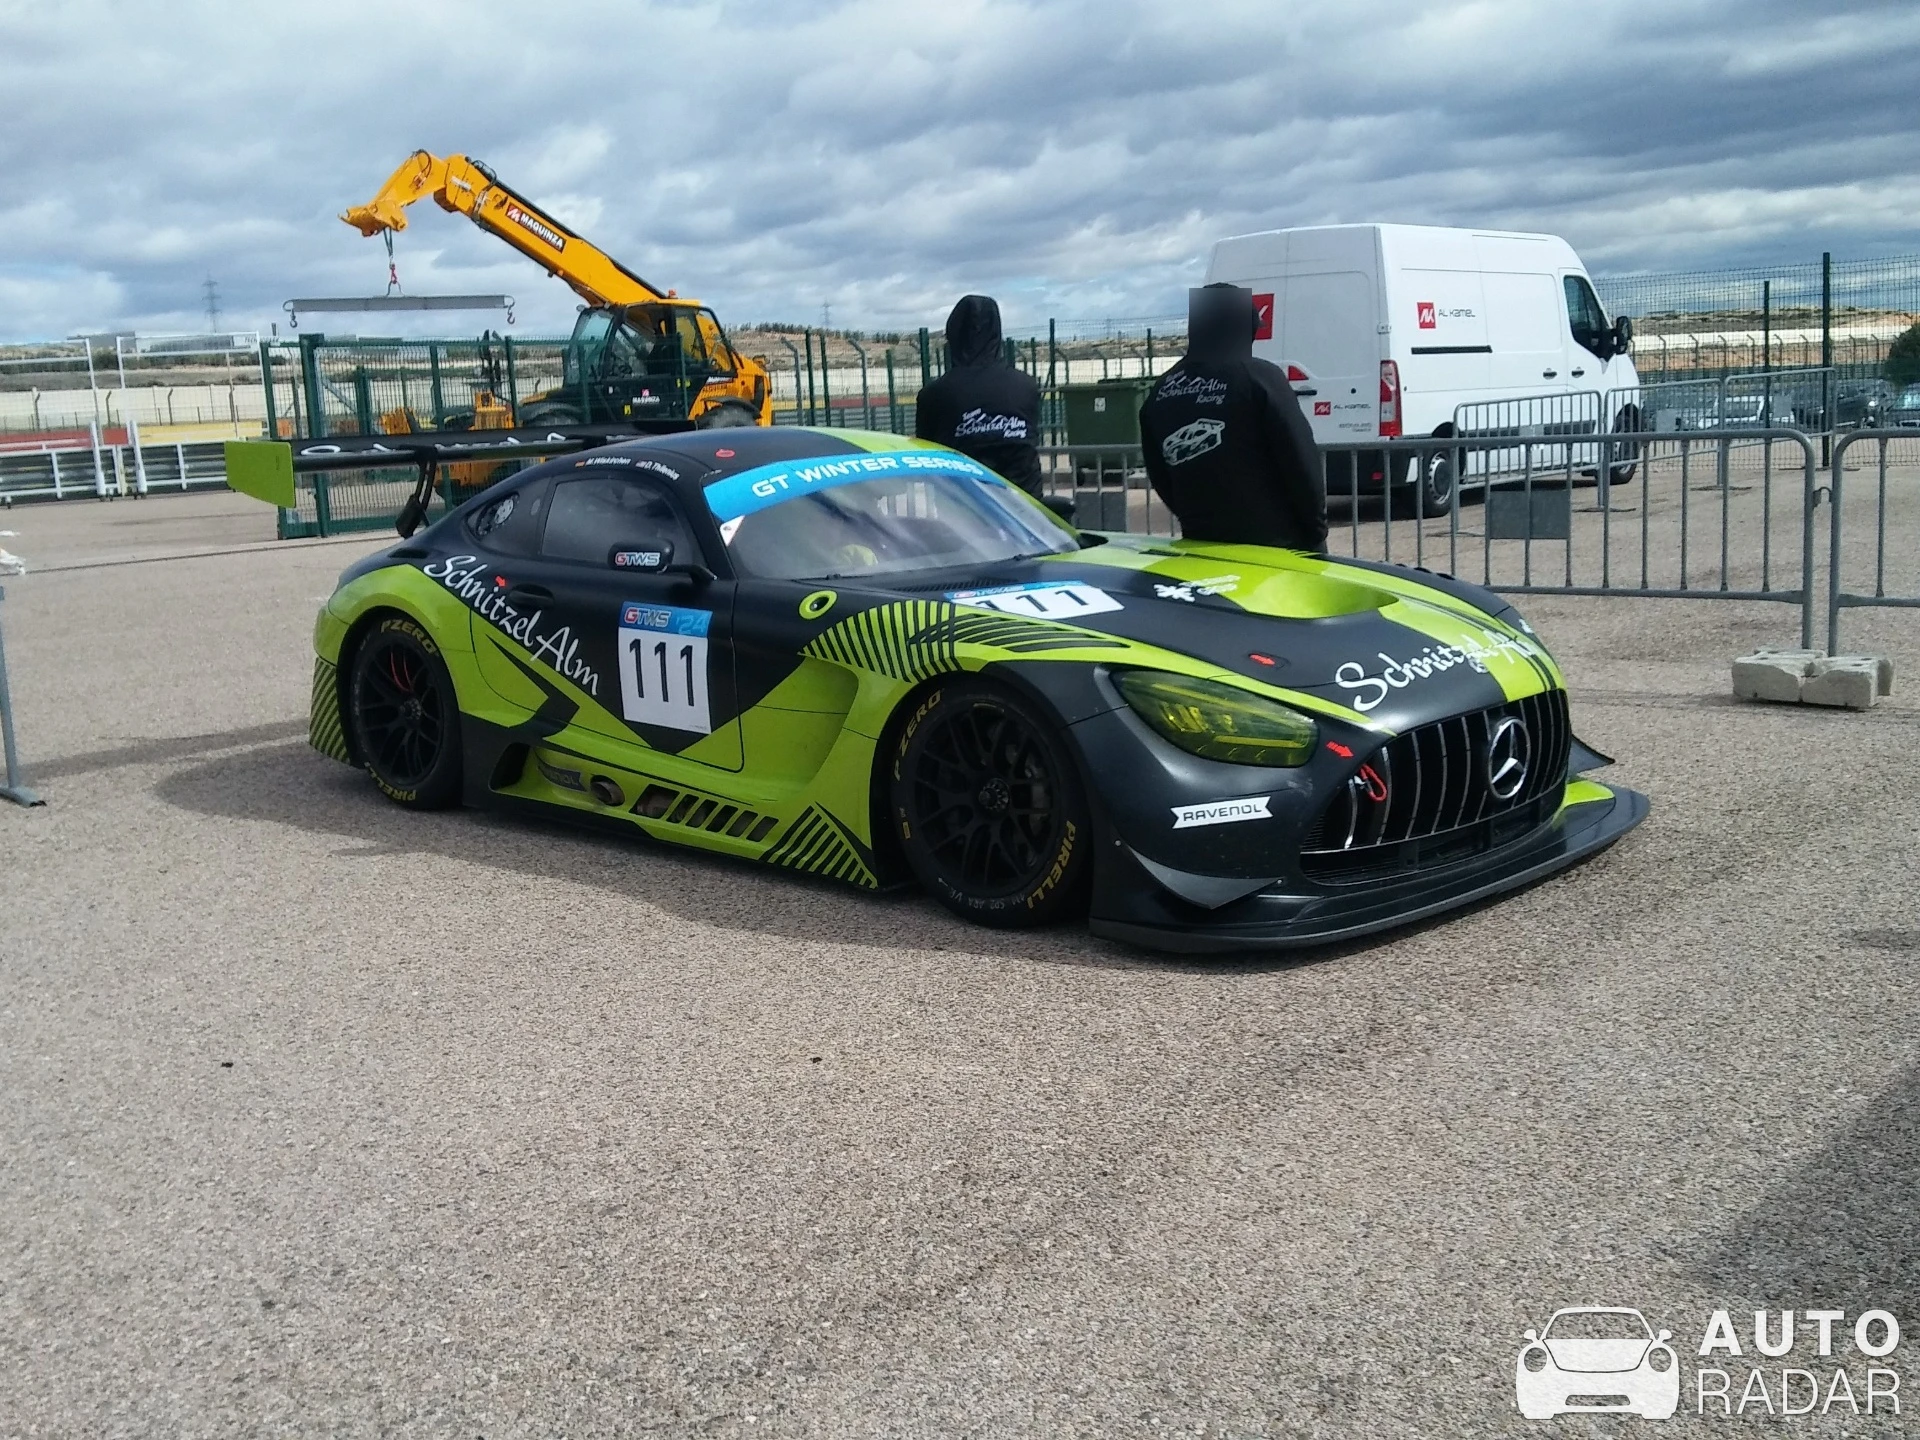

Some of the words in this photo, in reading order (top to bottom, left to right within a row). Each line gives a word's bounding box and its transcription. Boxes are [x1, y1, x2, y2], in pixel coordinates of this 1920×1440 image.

[520, 213, 564, 249] MAQUINZA
[1196, 394, 1226, 405] Racing
[752, 474, 790, 498] GT
[796, 457, 900, 483] WINTER
[901, 456, 984, 476] SERIES
[614, 552, 661, 567] GTWS
[624, 607, 671, 627] GTWS
[629, 638, 695, 707] 111
[1183, 803, 1263, 822] RAVENOL
[1027, 820, 1076, 909] PIRELLI
